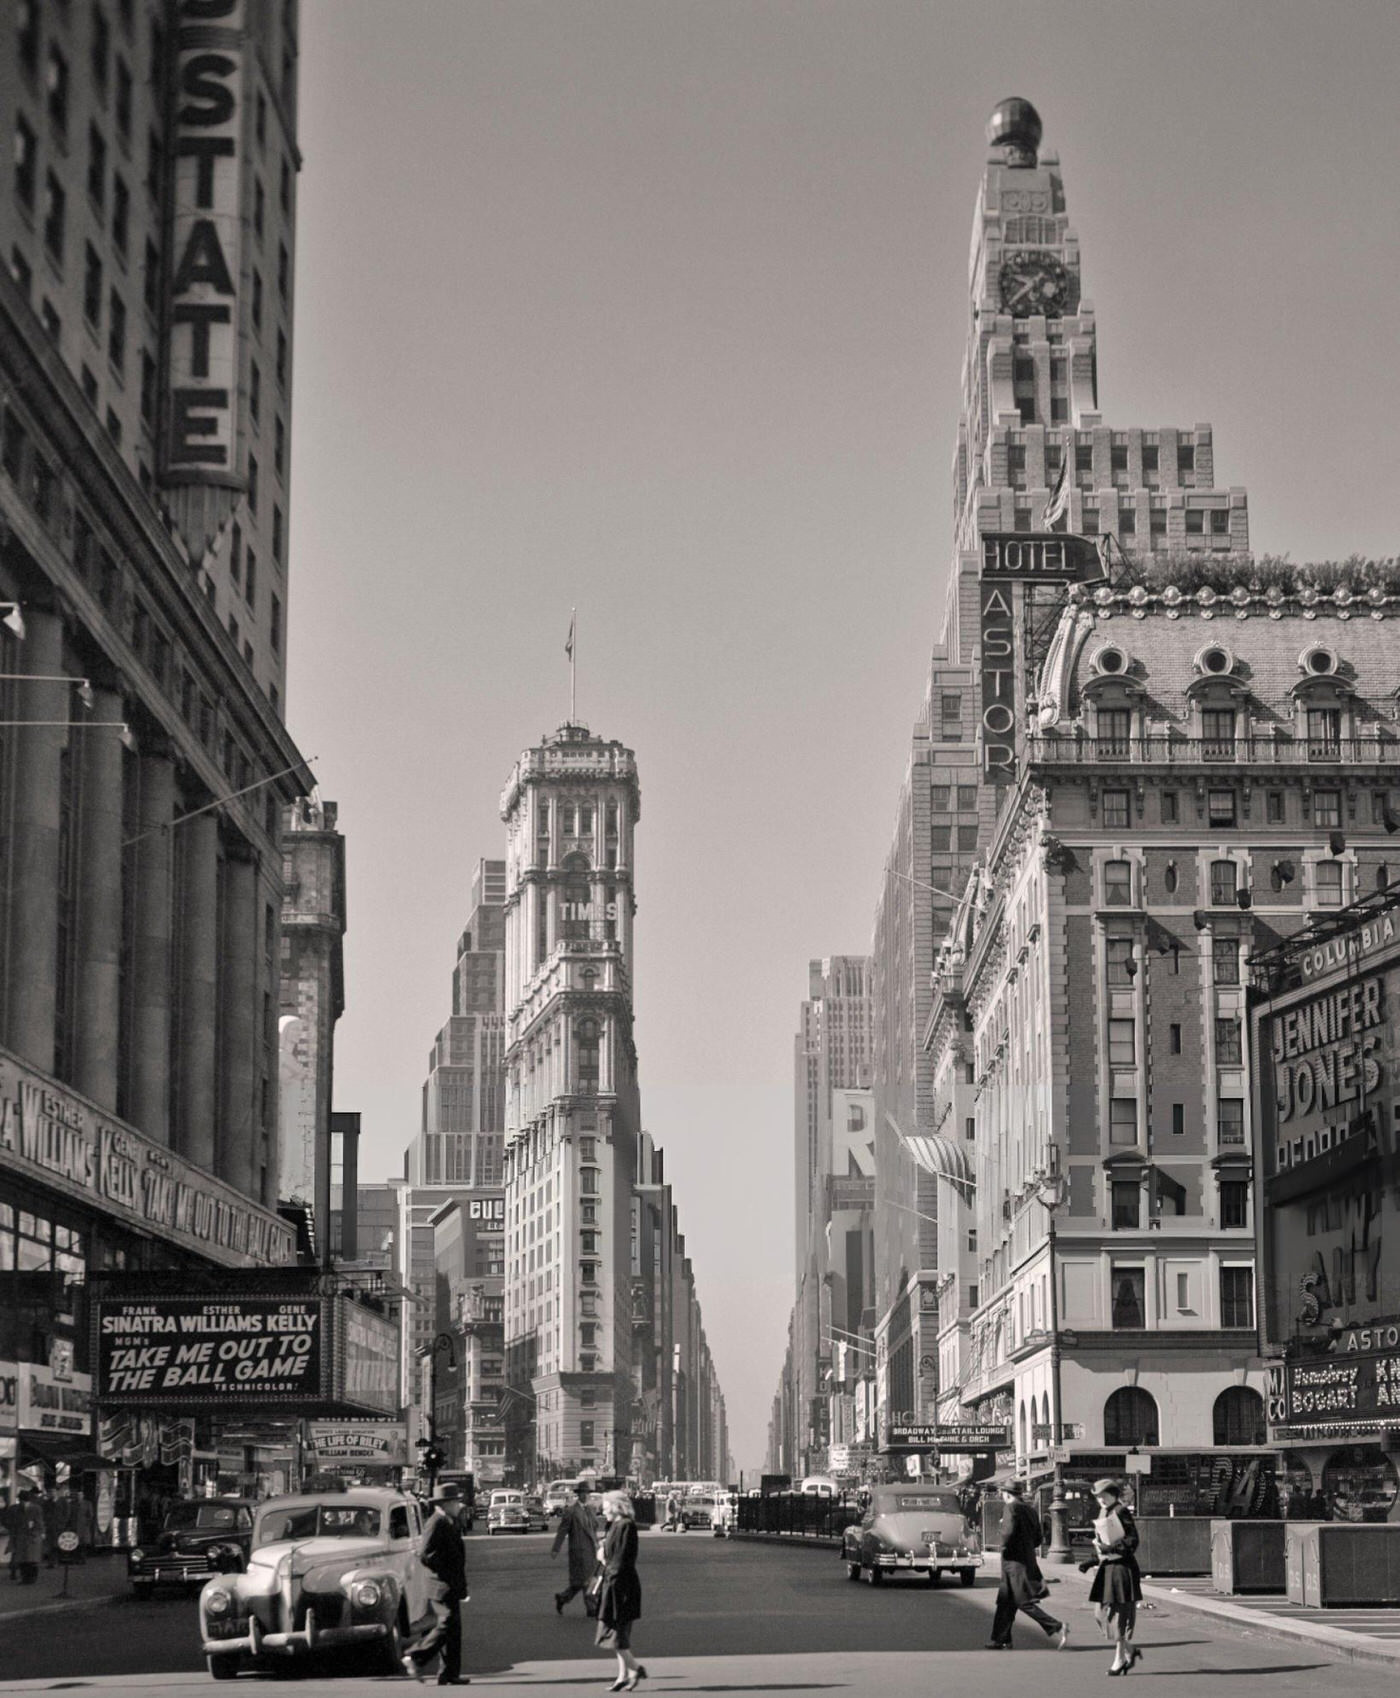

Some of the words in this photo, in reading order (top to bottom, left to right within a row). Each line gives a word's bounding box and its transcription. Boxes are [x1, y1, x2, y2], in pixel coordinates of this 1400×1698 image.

[172, 54, 238, 465] STATE
[983, 540, 1077, 571] HOTEL
[983, 589, 1015, 774] ASTOR
[1273, 978, 1381, 1062] JENNIFER
[1274, 1036, 1380, 1123] JONES
[99, 1126, 138, 1210] KELLY
[102, 1316, 177, 1334] SINATRA
[179, 1315, 263, 1333] WILLIAMS
[266, 1314, 317, 1332] KELLY
[122, 1306, 156, 1315] FRANK
[203, 1305, 240, 1315] ESTHER
[279, 1305, 306, 1314] GENE
[109, 1346, 170, 1371] TAKE
[175, 1342, 214, 1365] ME
[218, 1338, 269, 1361] OUT
[278, 1334, 312, 1355] TO
[1347, 1327, 1399, 1351] ASTO
[108, 1368, 157, 1392] THE
[162, 1364, 226, 1388] BALL
[234, 1355, 310, 1379] GAME
[1294, 1364, 1358, 1385] Humphrey
[1292, 1385, 1358, 1413] BOGART
[327, 1436, 346, 1446] LIFE
[346, 1435, 359, 1445] OF
[360, 1437, 385, 1449] RILEY
